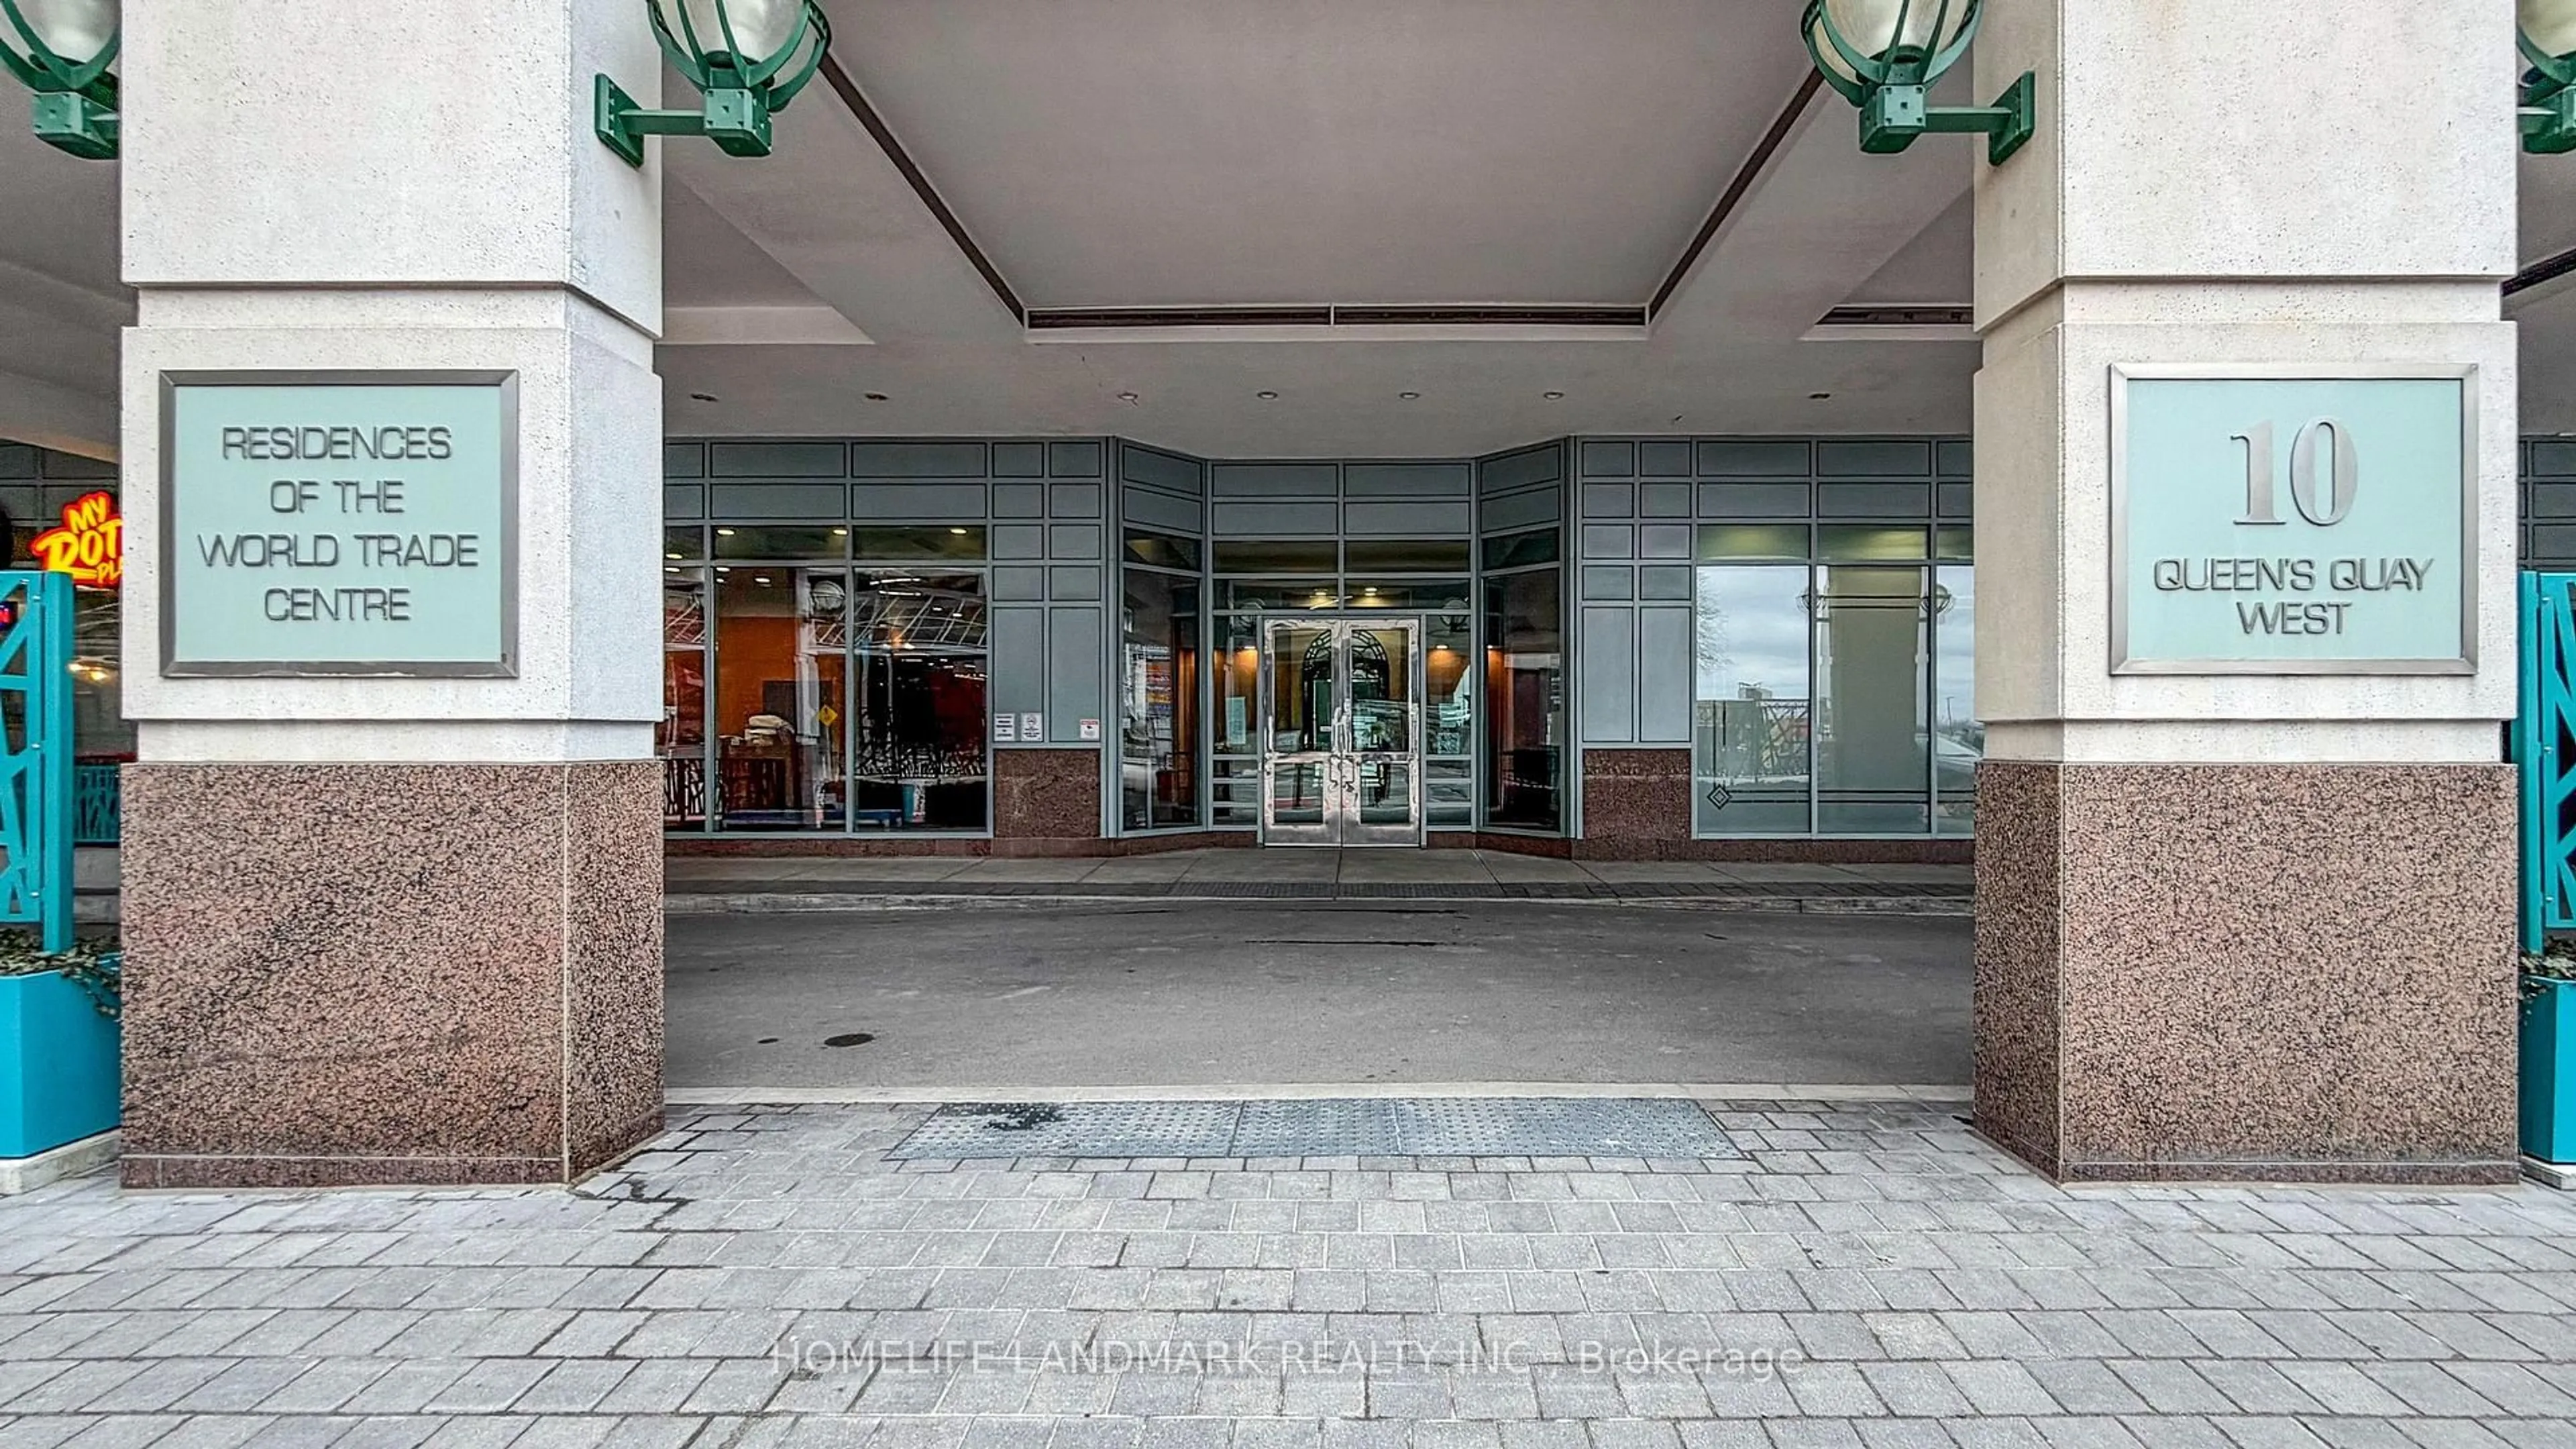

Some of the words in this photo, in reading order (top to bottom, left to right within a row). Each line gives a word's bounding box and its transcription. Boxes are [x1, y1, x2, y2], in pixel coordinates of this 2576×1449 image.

[222, 425, 452, 461] RESIDENCES
[2229, 415, 2359, 527] 10
[270, 480, 321, 514] OF
[331, 480, 405, 514] THE
[67, 496, 107, 534] MY
[197, 533, 339, 568] WORLD
[354, 533, 479, 568] TRADE
[96, 555, 123, 584] PL
[2153, 557, 2316, 592] QUEEN'S
[2329, 557, 2434, 592] QUAY
[264, 587, 411, 622] CENTRE
[2236, 601, 2353, 636] WEST
